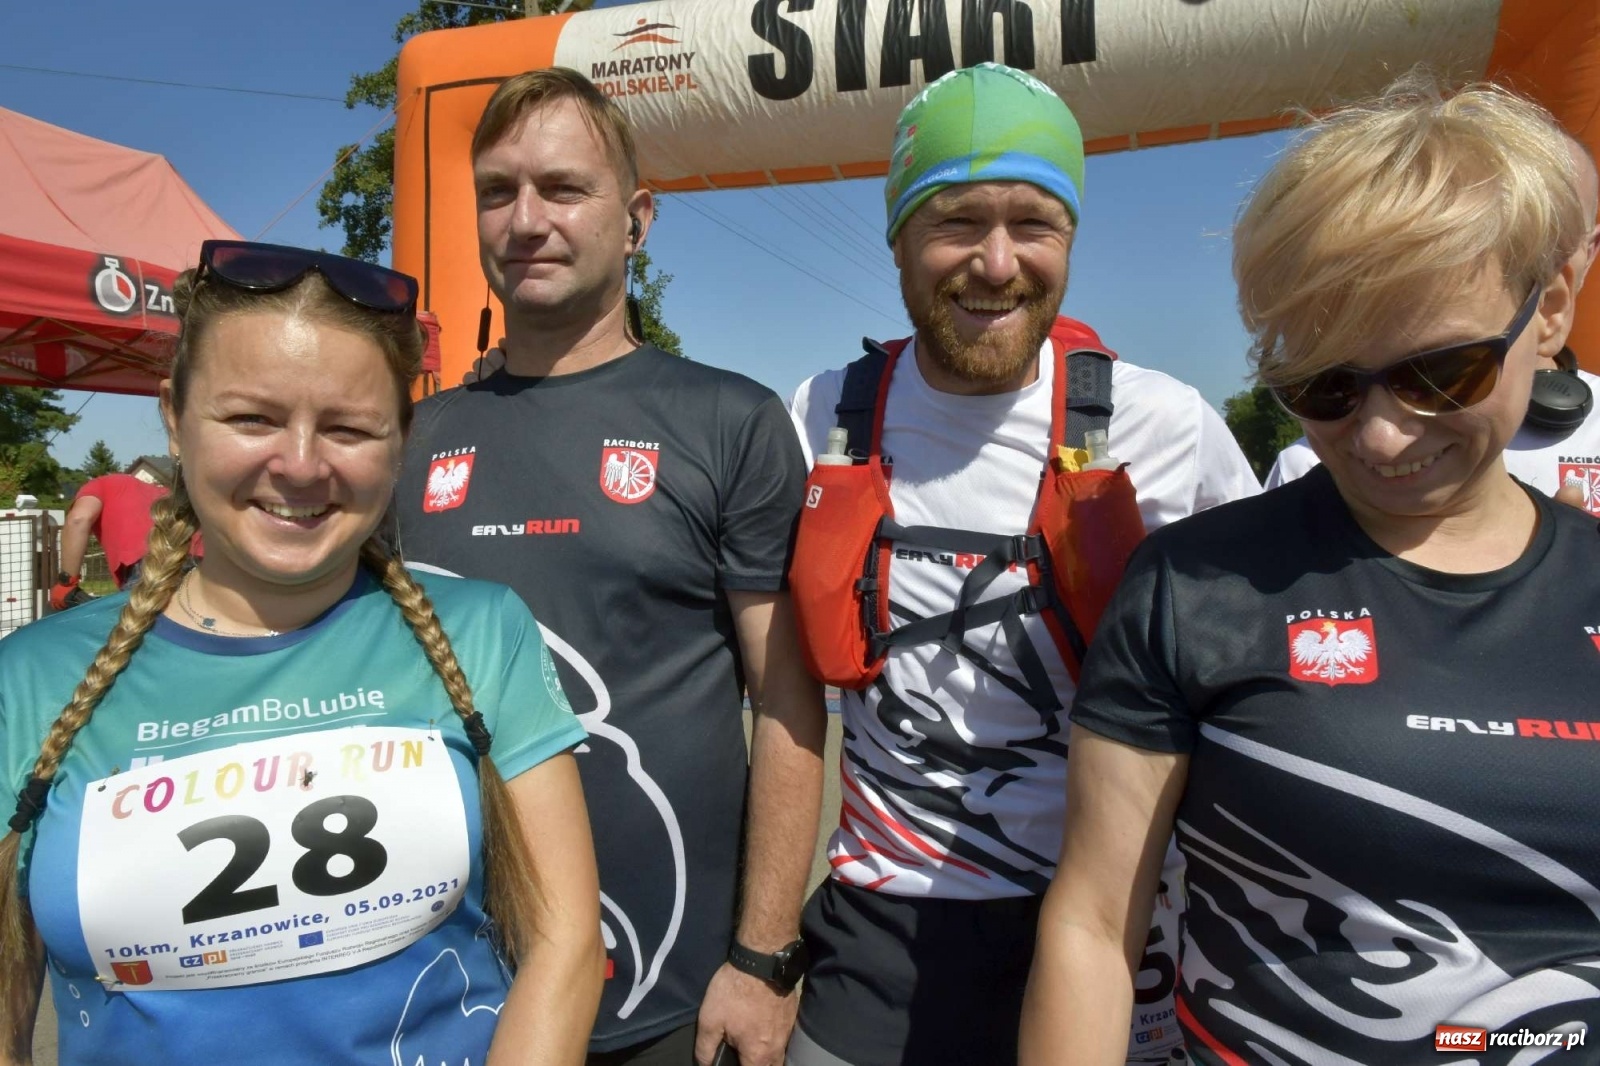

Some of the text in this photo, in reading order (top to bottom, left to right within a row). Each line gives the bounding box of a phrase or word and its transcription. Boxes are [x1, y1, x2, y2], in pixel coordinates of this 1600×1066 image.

[591, 52, 696, 79] MARATONY
[431, 445, 477, 461] POLSKA
[603, 438, 660, 450] RACIBÓRZ
[1286, 607, 1371, 624] POLSKA
[137, 688, 385, 742] BiegamBoLubię
[111, 739, 424, 820] COLOUR RUN
[176, 795, 388, 925] 28
[105, 942, 179, 959] 10km,
[190, 912, 330, 948] Krzanowice,
[344, 878, 459, 916] 05.09.2021
